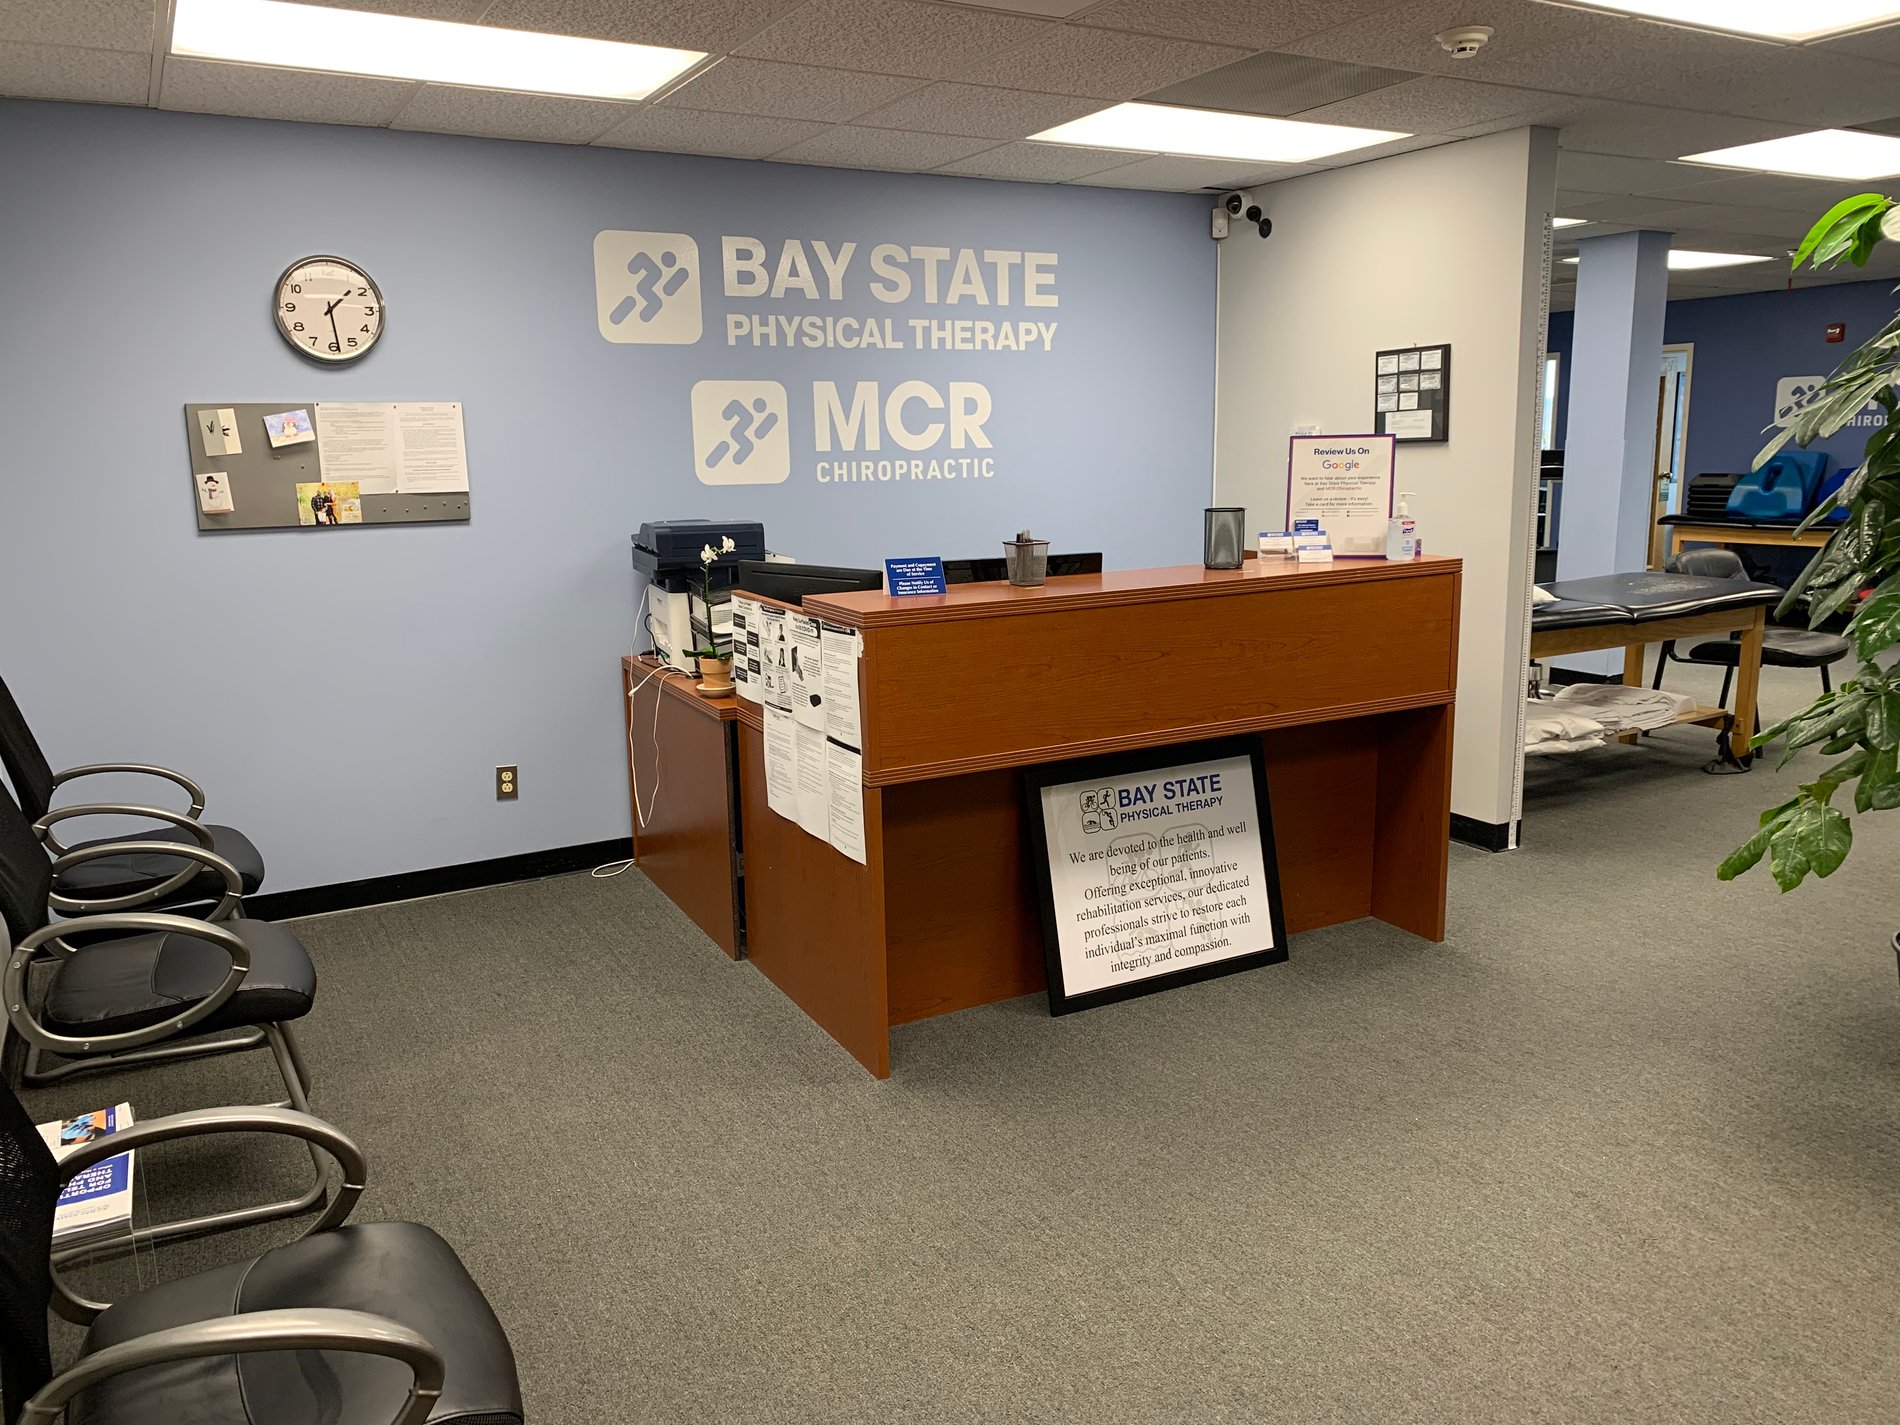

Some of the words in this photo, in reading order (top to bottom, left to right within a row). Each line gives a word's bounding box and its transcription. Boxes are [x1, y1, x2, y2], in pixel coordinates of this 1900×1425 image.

[721, 236, 856, 300] BAY
[871, 244, 1059, 308] STATE
[291, 284, 301, 294] 10
[358, 288, 368, 296] 2
[285, 303, 296, 312] 9
[364, 306, 375, 316] 3
[294, 322, 304, 332] 8
[360, 324, 370, 333] 4
[726, 314, 903, 348] PHYSICAL
[909, 319, 1058, 351] THERAPY
[309, 337, 318, 346] 7
[329, 342, 339, 352] 6
[347, 337, 357, 347] 5
[813, 381, 993, 452] MCR
[1846, 415, 1888, 426] HIRO
[816, 458, 994, 483] CHIROPRACTIC
[1323, 460, 1359, 471] Google
[1118, 784, 1157, 808] BAY
[1164, 774, 1222, 800] STATE
[1121, 805, 1173, 823] PHYSICAL
[1176, 796, 1223, 813] THERAPY
[1069, 852, 1085, 864] We
[1088, 851, 1104, 862] are
[1107, 840, 1145, 859] devoted
[1148, 840, 1157, 851] to
[1160, 835, 1175, 848] the
[1177, 830, 1205, 845] health
[1208, 826, 1224, 839] and
[1227, 822, 1247, 835] well
[1110, 859, 1137, 877] being
[1140, 858, 1151, 870] of
[1153, 857, 1168, 868] our
[1171, 850, 1210, 869] patients.
[1084, 882, 1127, 901] Offering
[1129, 871, 1187, 896] exceptional,
[1189, 860, 1238, 881] innovative
[1076, 901, 1141, 922] rehabilitation
[1144, 890, 1185, 907] services,
[1188, 887, 1203, 898] our
[1206, 876, 1249, 895] dedicated
[1084, 916, 1148, 941] professionals
[1152, 910, 1177, 925] strive
[1180, 907, 1189, 918] to
[1192, 901, 1223, 917] restore
[1226, 895, 1247, 910] each
[1085, 937, 1143, 959] individual's
[1146, 927, 1187, 945] maximal
[1190, 918, 1228, 936] function
[1230, 913, 1251, 927] with
[1111, 953, 1151, 974] integrity
[1154, 948, 1172, 962] and
[1174, 939, 1232, 961] compassion.
[71, 1168, 112, 1181] THERA
[88, 1173, 112, 1182] AND
[89, 1178, 111, 1187] FOR
